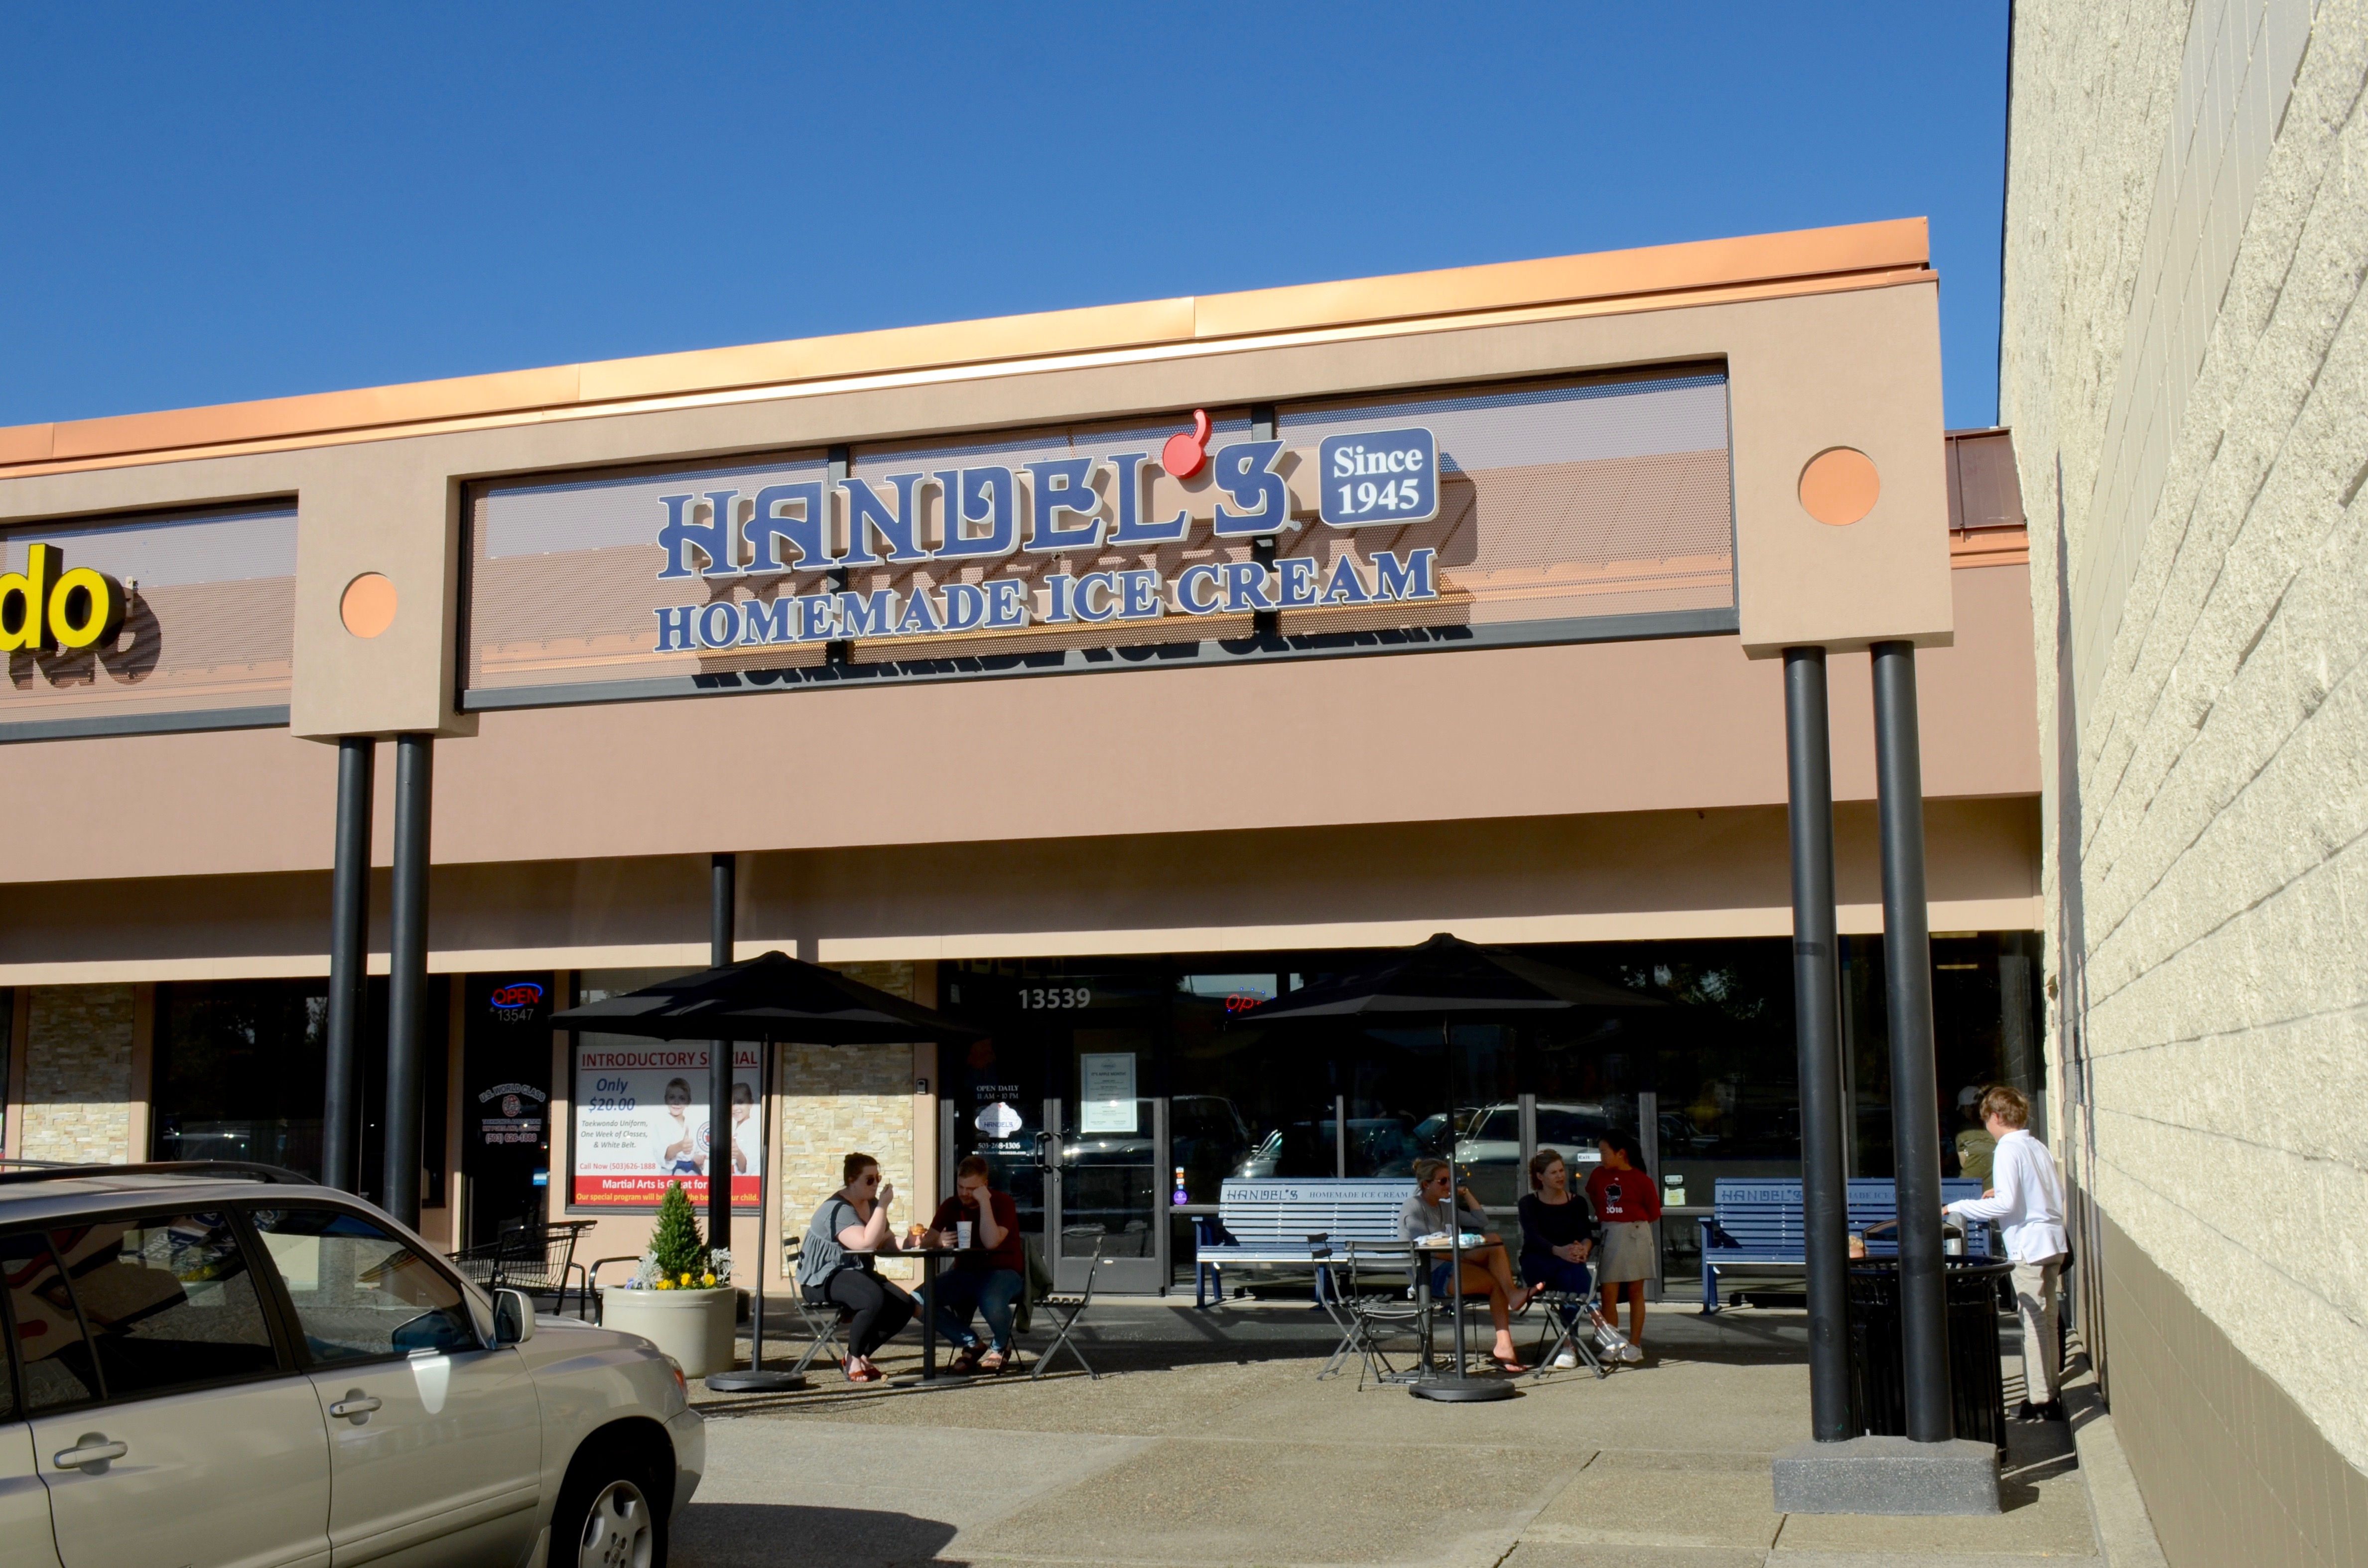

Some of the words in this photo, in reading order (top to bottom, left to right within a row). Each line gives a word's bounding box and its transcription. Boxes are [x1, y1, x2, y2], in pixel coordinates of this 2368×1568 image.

[1333, 444, 1424, 478] Since
[657, 408, 1290, 580] HANDEL'S
[1338, 478, 1421, 515] 1945
[654, 578, 1024, 653] HOMEMADE
[1044, 568, 1162, 624] ICE
[1176, 547, 1438, 616] CREAM
[492, 988, 540, 1005] OPEN
[1019, 987, 1091, 1010] 13539
[497, 1008, 534, 1022] 13547
[582, 1051, 696, 1066] INTRODUCTORY
[700, 1051, 757, 1065] SIAL
[479, 1089, 494, 1102] U.S.
[493, 1083, 521, 1096] WORLD
[521, 1084, 546, 1102] CLASS
[596, 1077, 629, 1094] Only
[589, 1096, 636, 1113] $20.00
[486, 1133, 504, 1145] (503)
[504, 1134, 537, 1142] 626-1888
[615, 1130, 623, 1139] of
[610, 1163, 657, 1171] (503)626-1888
[602, 1179, 636, 1189] Martial
[637, 1179, 656, 1189] Arts
[657, 1179, 665, 1188] is
[666, 1179, 692, 1189] Geat
[694, 1178, 708, 1189] for
[590, 1193, 613, 1201] special
[1227, 1189, 1298, 1200] HANDEL'S
